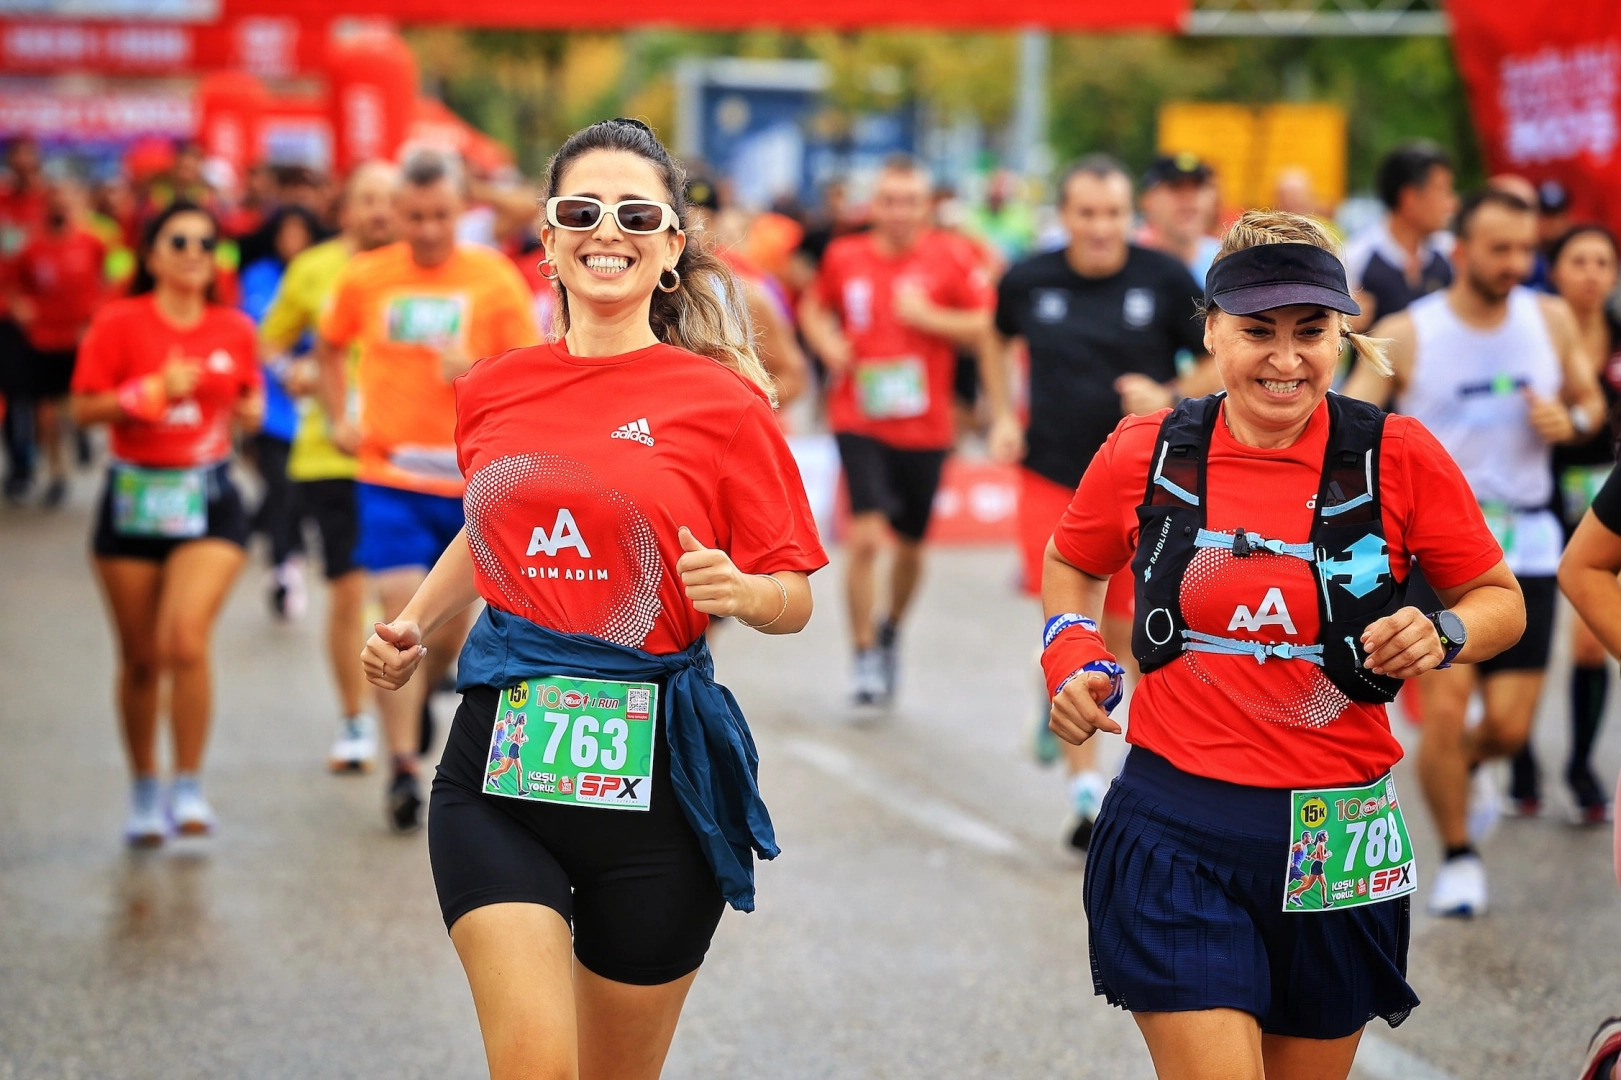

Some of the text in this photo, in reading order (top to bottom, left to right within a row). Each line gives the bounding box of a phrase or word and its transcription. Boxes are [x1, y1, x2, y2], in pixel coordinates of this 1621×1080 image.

[611, 430, 655, 447] adidas
[1150, 515, 1173, 565] RAIDLIGHT
[565, 568, 609, 581] ADIM
[598, 698, 619, 708] RUN
[542, 711, 629, 771] 763
[527, 782, 556, 794] YORUZ
[579, 775, 642, 799] SPX
[1302, 804, 1326, 823] 15K
[1343, 811, 1403, 872] 788
[1372, 863, 1411, 893] SPX
[1331, 890, 1354, 900] YORUZ
